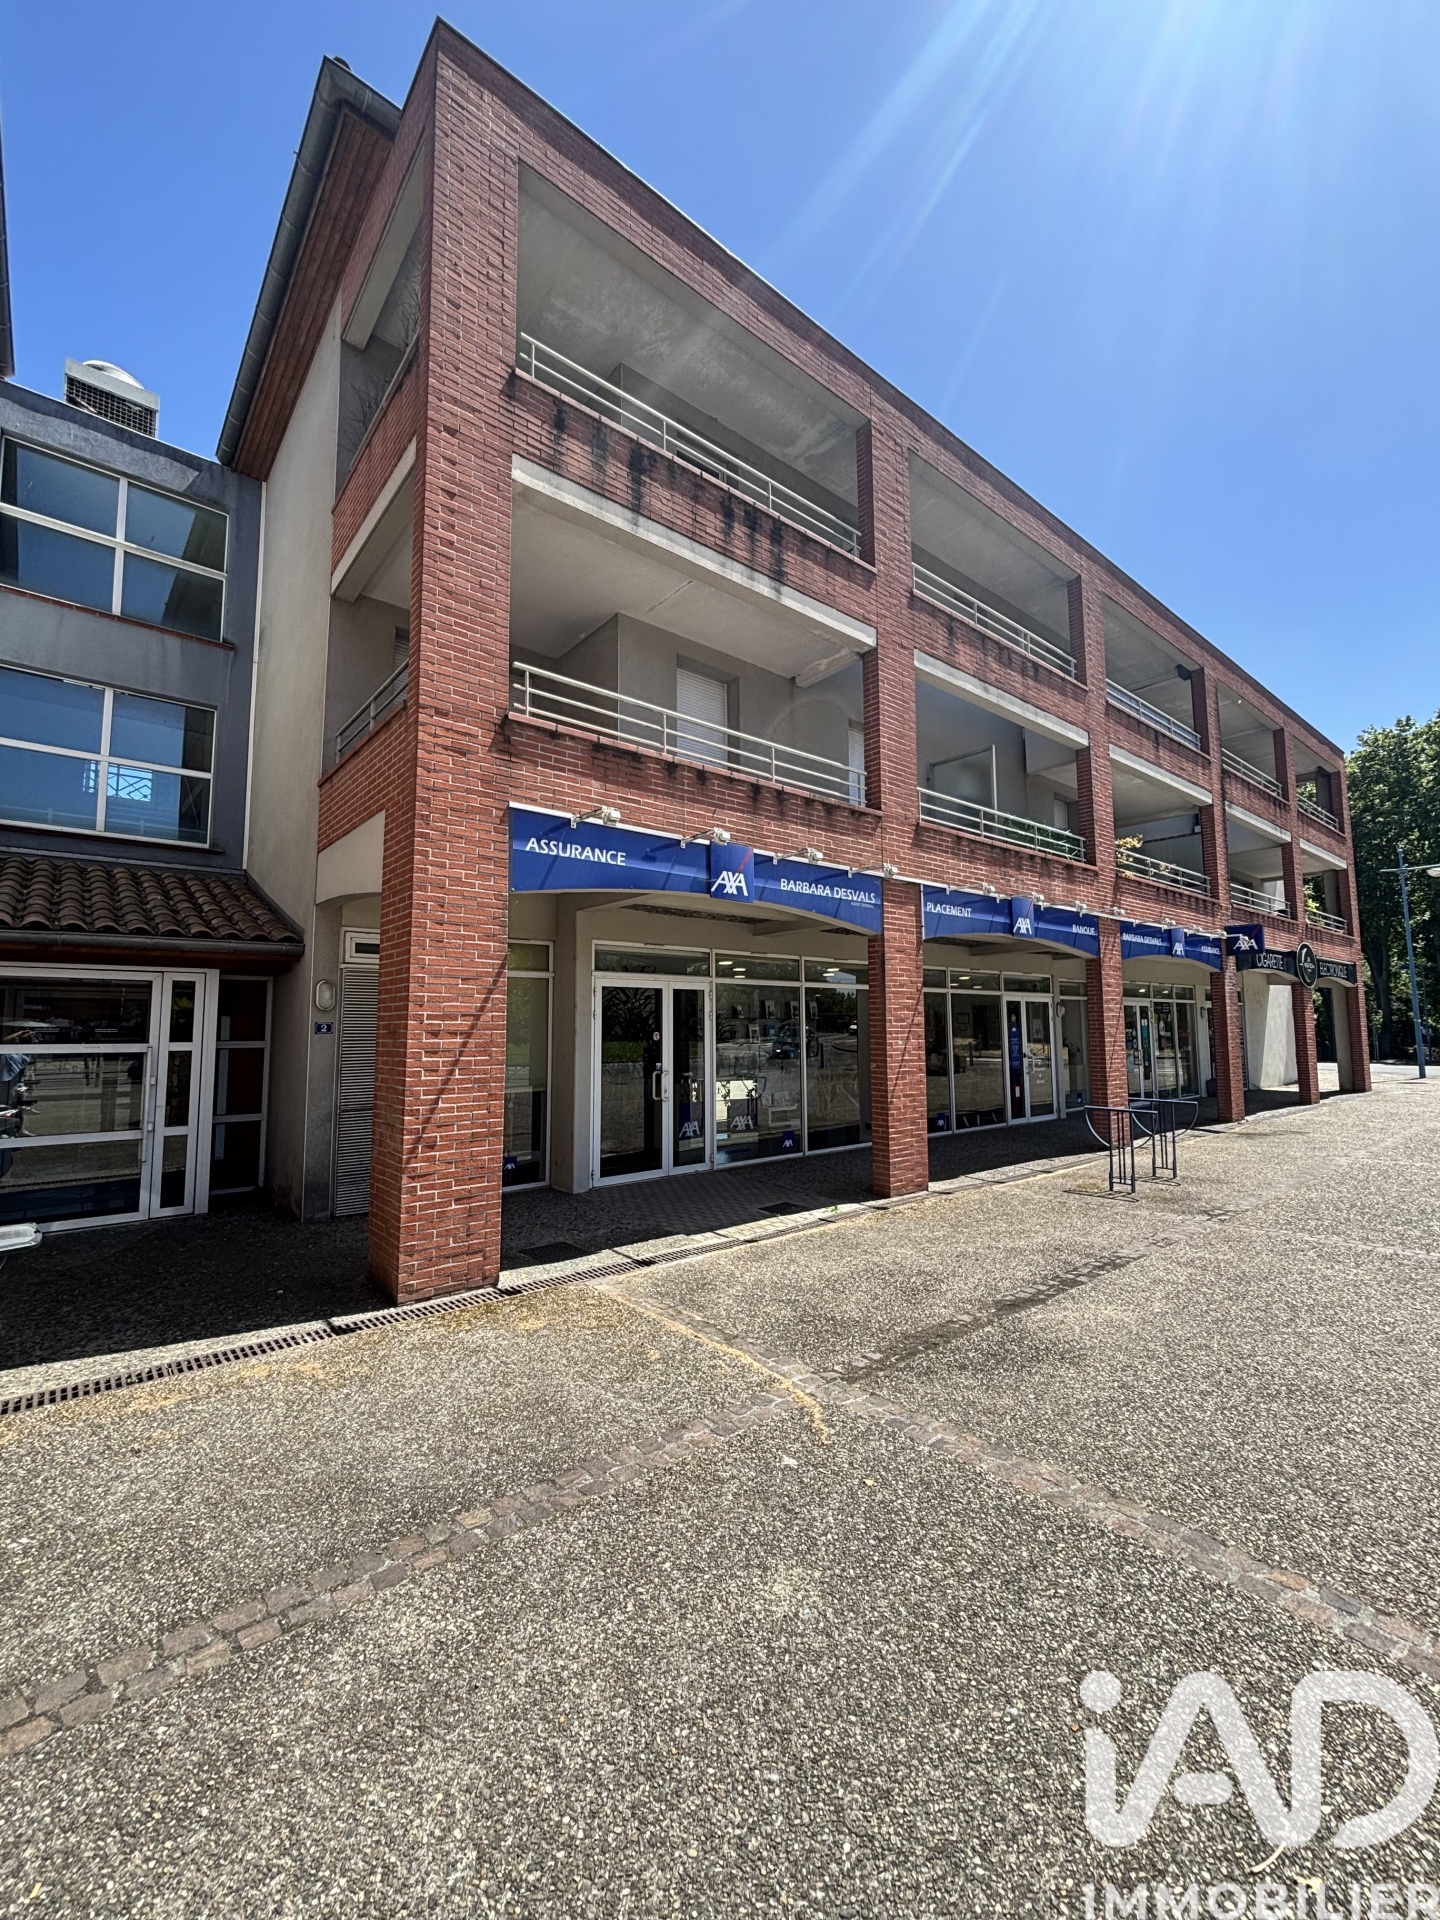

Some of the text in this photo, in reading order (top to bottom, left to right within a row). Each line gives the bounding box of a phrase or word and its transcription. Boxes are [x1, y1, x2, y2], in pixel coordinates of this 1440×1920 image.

[525, 837, 627, 866] ASSURANCE
[711, 870, 748, 897] AXA
[780, 878, 876, 904] BARBARA DESVALS
[926, 902, 972, 918] PLACEMENT
[1013, 917, 1032, 935] AXA
[1072, 924, 1096, 936] BANQUE
[1172, 942, 1185, 956] AXA
[1233, 938, 1259, 951] AXA
[1255, 952, 1284, 970] CIGARETTE
[320, 1024, 328, 1033] 2
[679, 1120, 701, 1138] AXA
[730, 1115, 754, 1131] AXA
[782, 1139, 794, 1148] AXA
